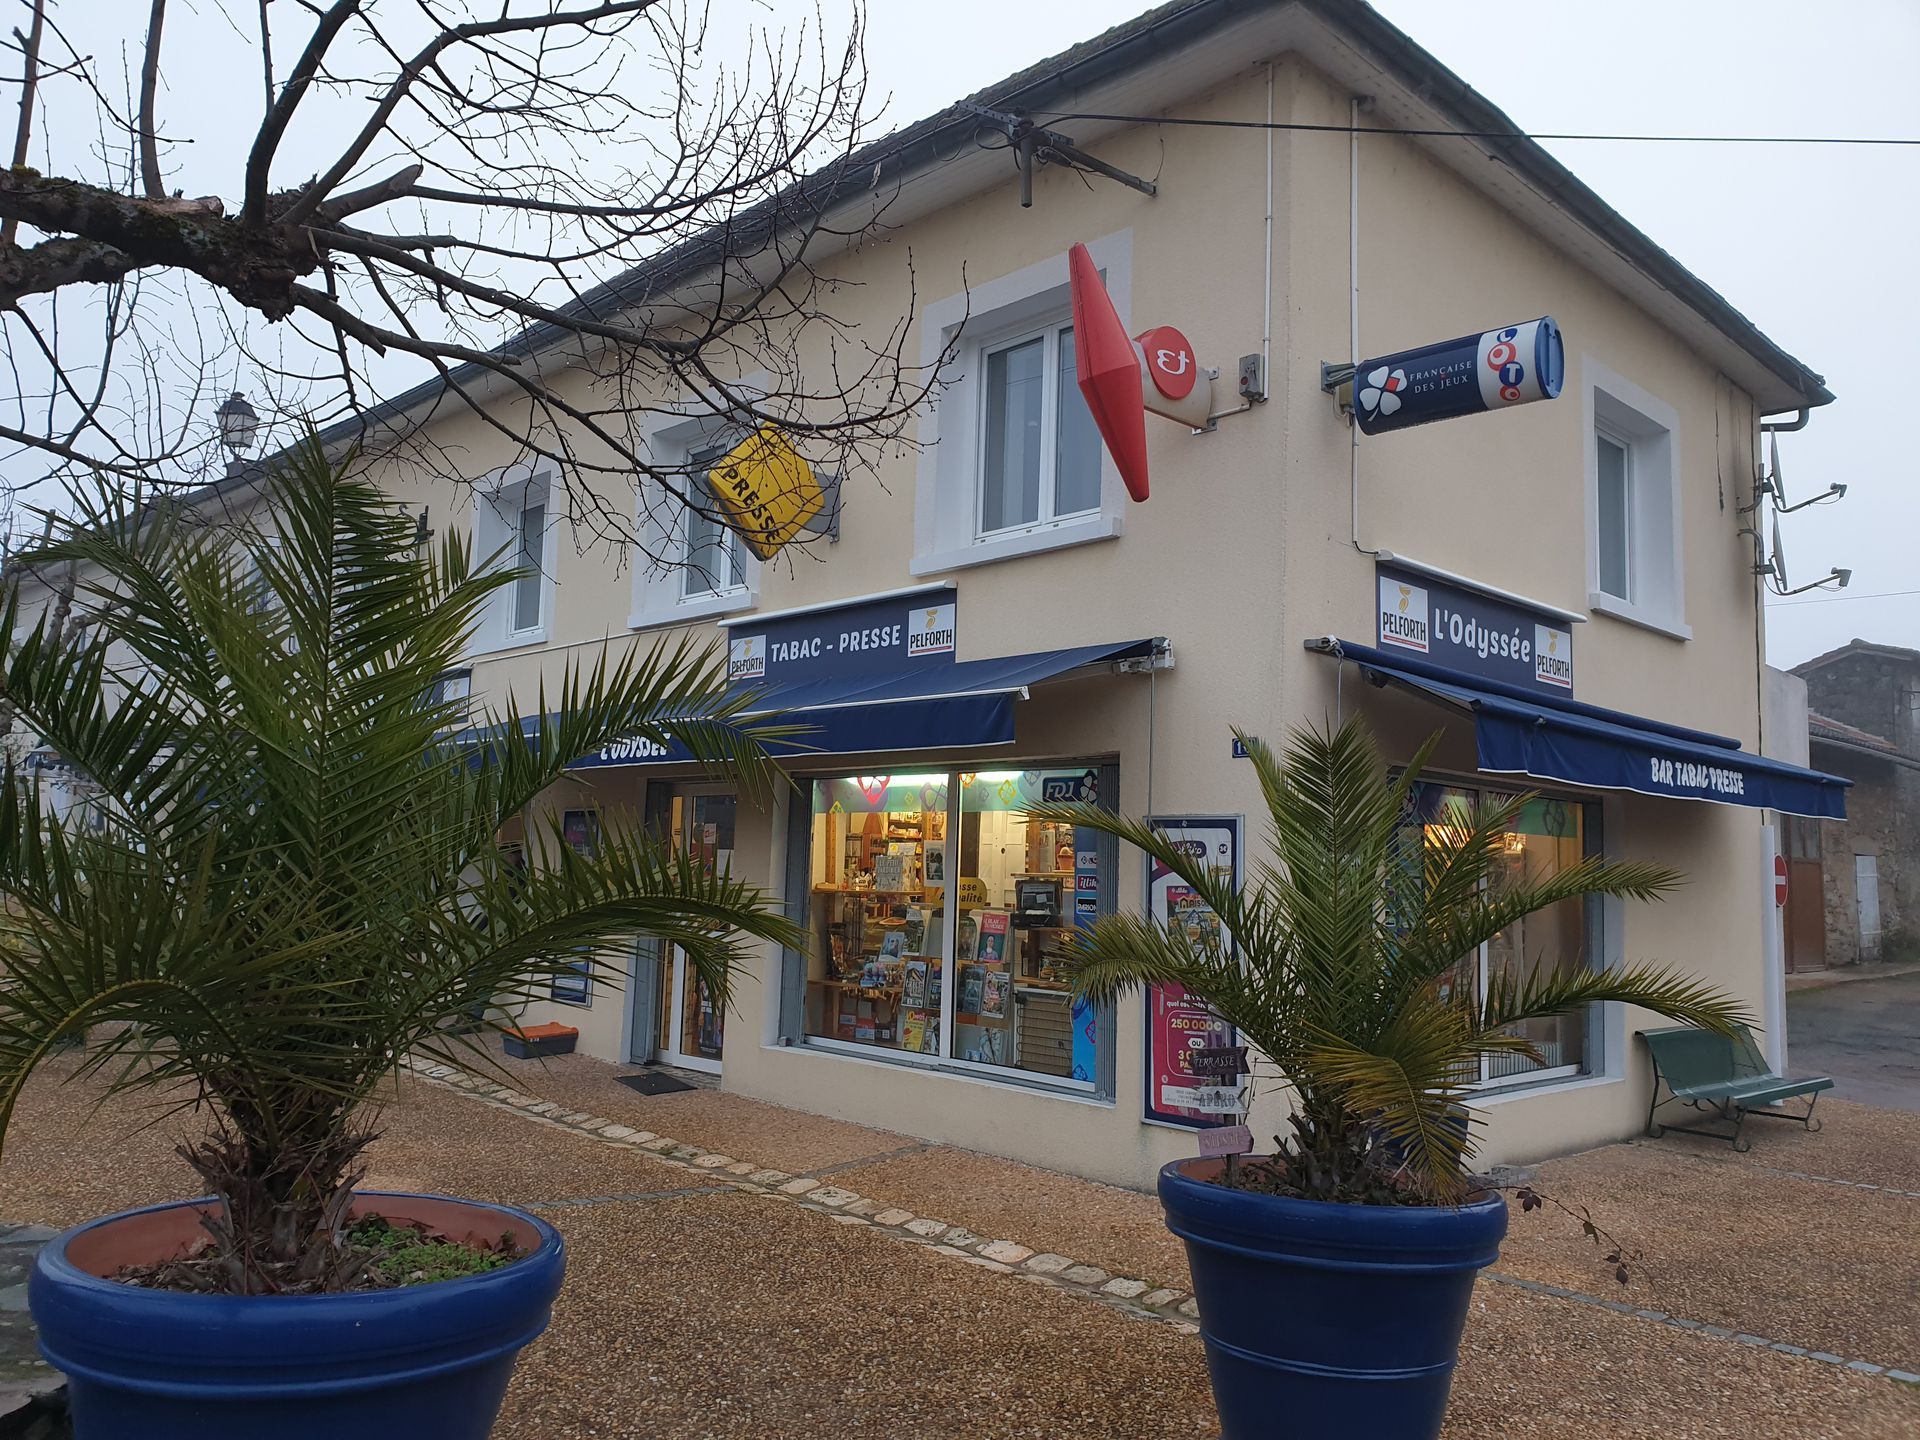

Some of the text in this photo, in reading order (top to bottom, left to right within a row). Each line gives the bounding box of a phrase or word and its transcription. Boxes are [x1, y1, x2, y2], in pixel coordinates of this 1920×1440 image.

[1409, 360, 1473, 382] FRANÇAISE
[1414, 374, 1469, 394] DES JEUX
[720, 467, 781, 544] PRESSE
[1382, 611, 1427, 642] PELFORTH
[1434, 608, 1531, 663] L'Odyssée
[771, 636, 821, 663] TABAC
[839, 624, 901, 654] PRESSE
[909, 629, 953, 649] PELFORTH
[1536, 653, 1570, 679] PELFORTH
[1650, 757, 1745, 795] BAR TABAC PRESSE
[1045, 781, 1075, 799] FDJ
[1171, 1018, 1190, 1029] 250
[1193, 1056, 1234, 1068] TERRASSE
